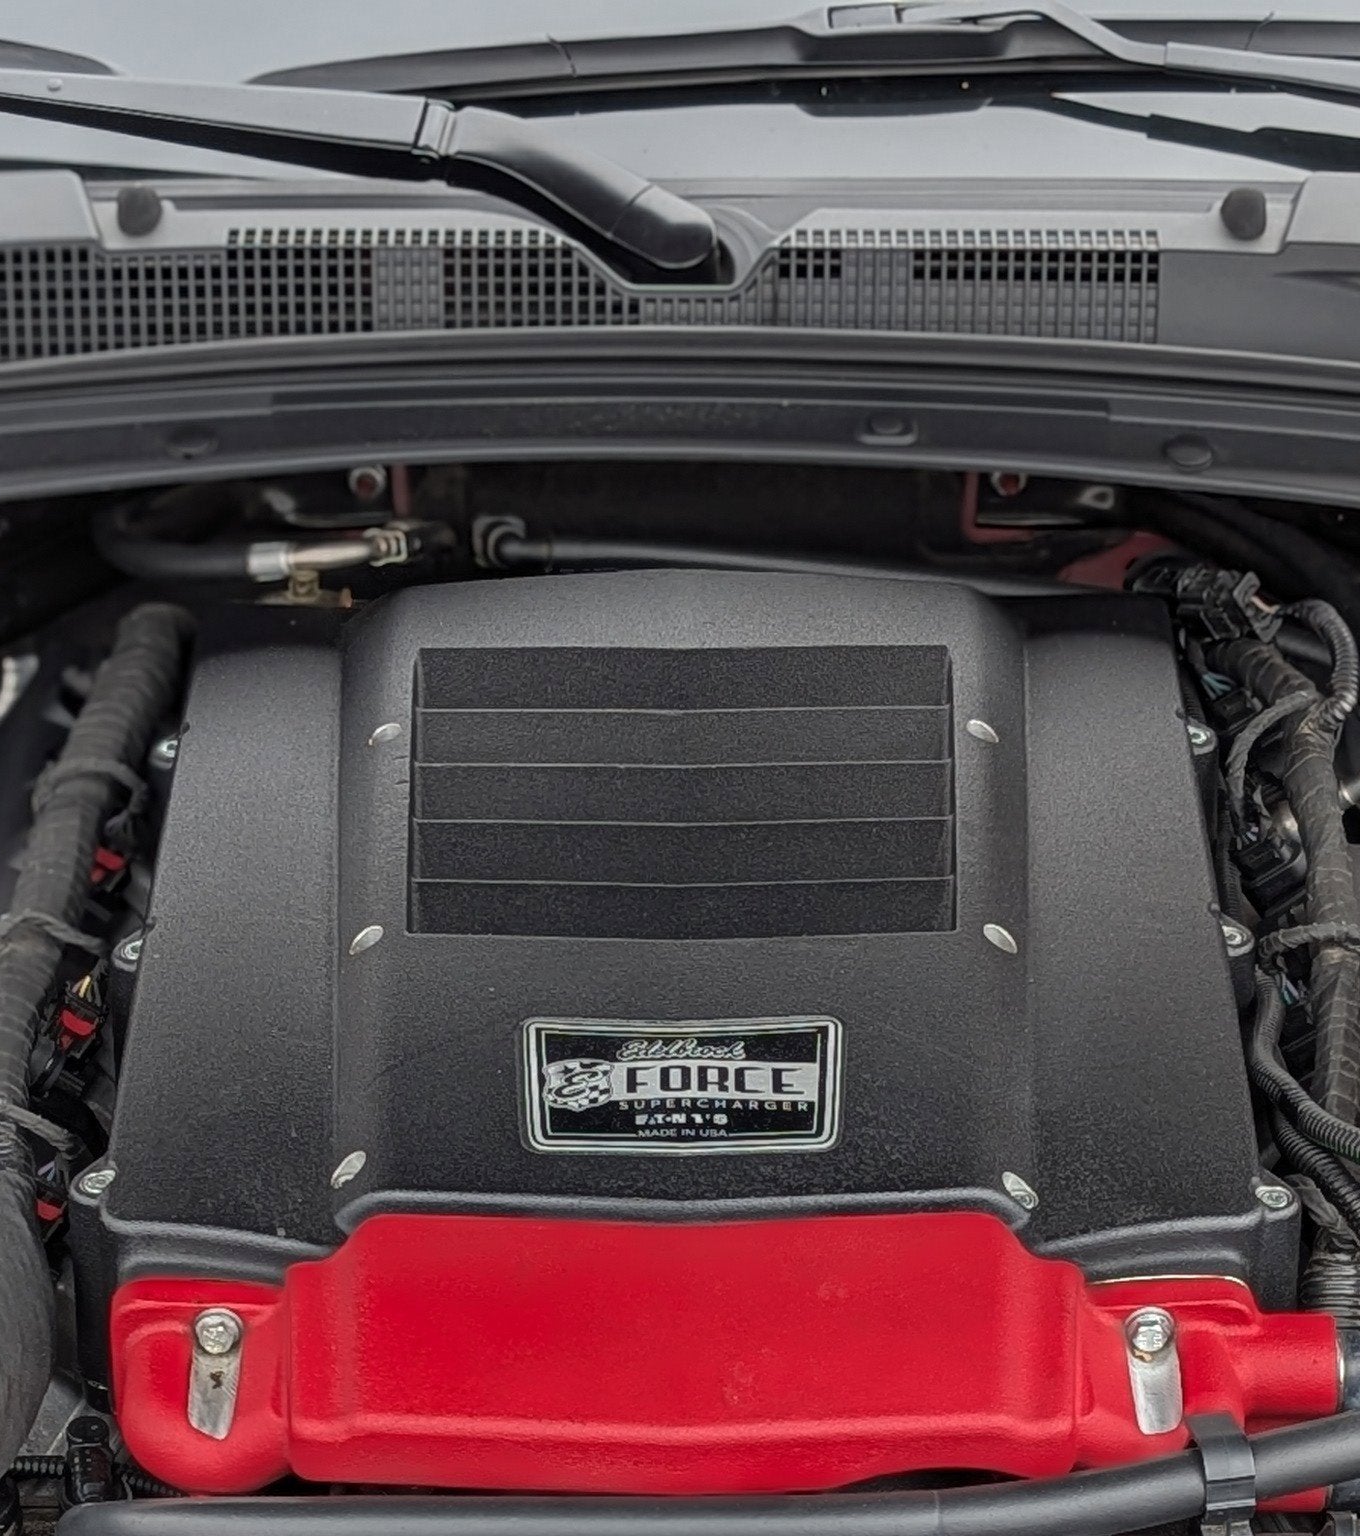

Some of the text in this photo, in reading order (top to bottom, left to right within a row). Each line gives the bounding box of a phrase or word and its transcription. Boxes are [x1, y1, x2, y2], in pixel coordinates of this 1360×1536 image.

[616, 1038, 746, 1061] Edelbrock
[626, 1065, 805, 1094] FORCE
[618, 1100, 809, 1112] SUPERCHARGER
[637, 1128, 729, 1138] MADE IN USA
